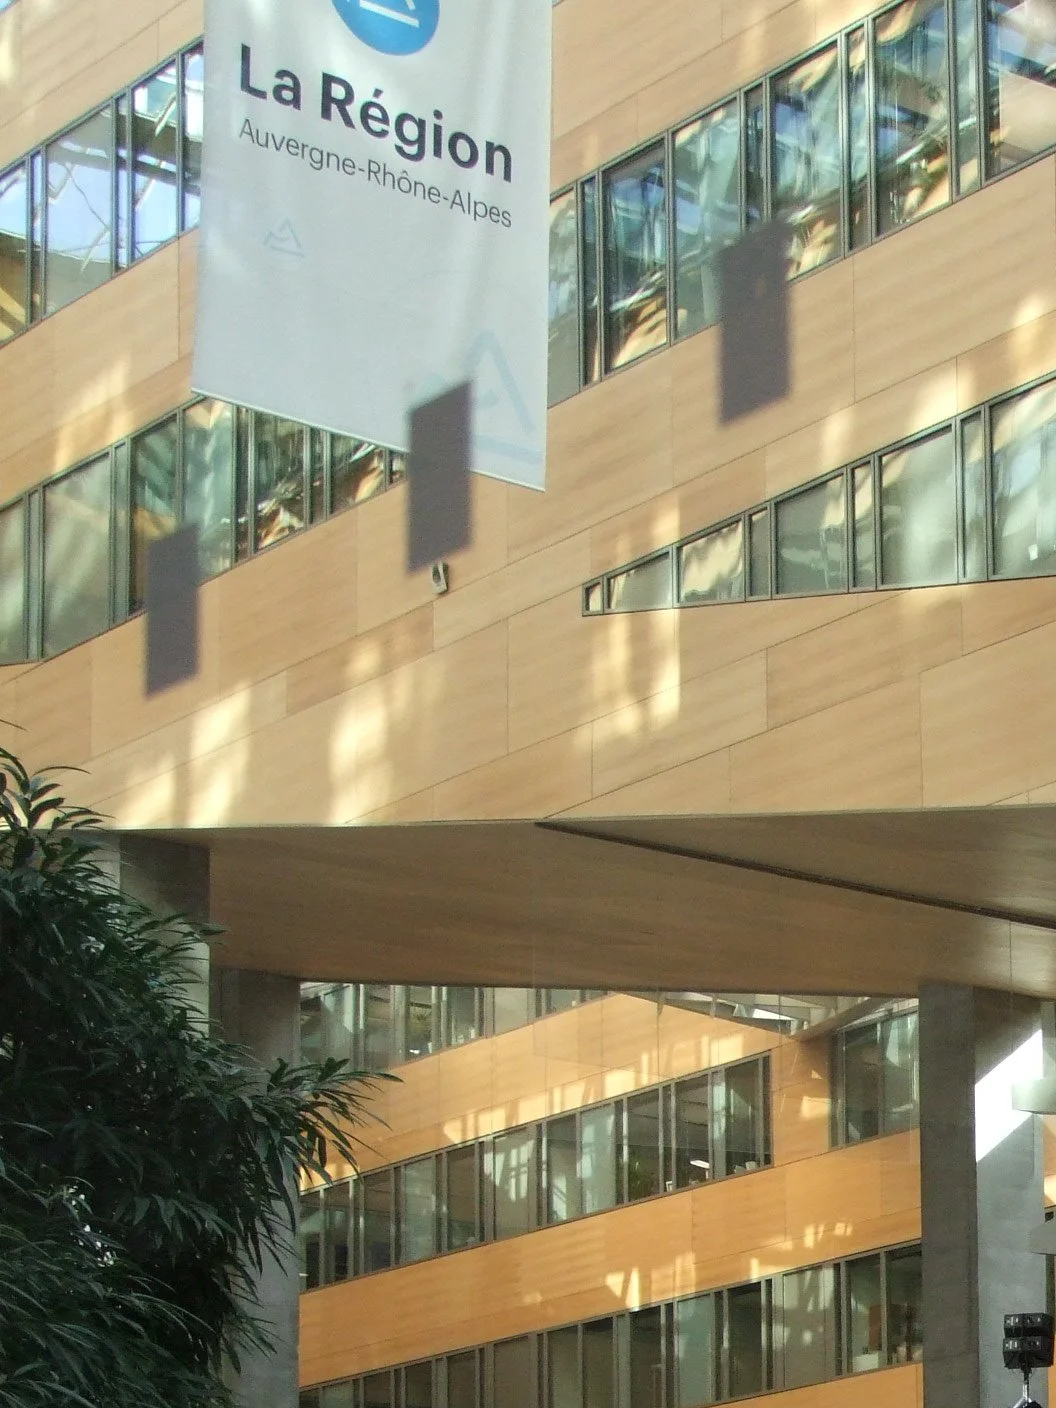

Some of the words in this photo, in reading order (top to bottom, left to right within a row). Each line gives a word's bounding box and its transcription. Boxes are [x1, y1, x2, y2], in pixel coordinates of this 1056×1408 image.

[239, 118, 512, 228] Auvergne-Rhône-Alpes
[240, 43, 301, 111] La
[320, 72, 512, 183] Région
